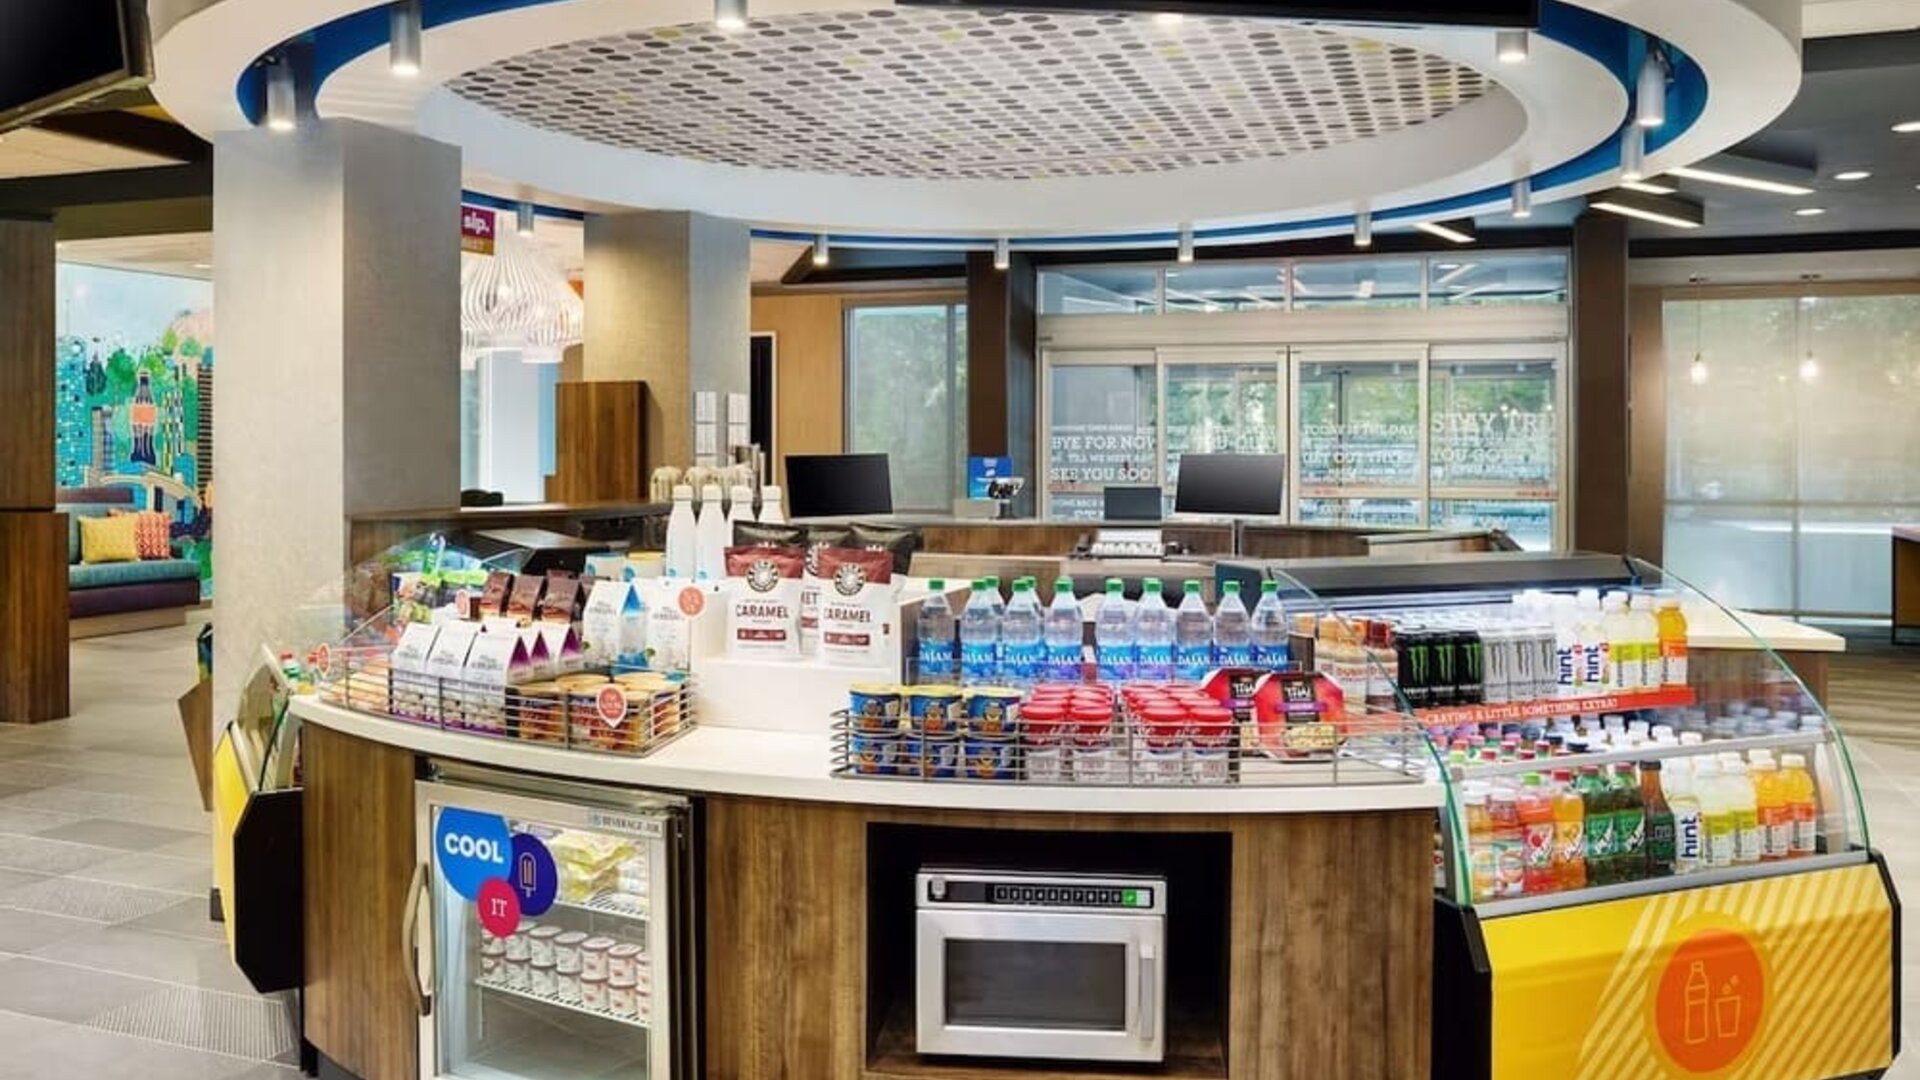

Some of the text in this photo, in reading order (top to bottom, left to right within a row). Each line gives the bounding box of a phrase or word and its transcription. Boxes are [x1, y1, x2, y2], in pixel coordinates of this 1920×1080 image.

[463, 211, 491, 235] sip.
[1052, 436, 1081, 450] BYE
[1084, 435, 1118, 450] FOR
[1081, 467, 1115, 481] YOU
[736, 603, 790, 619] CARAMEL
[824, 605, 871, 623] CARAMEL
[1556, 648, 1572, 685] hint
[1584, 645, 1599, 683] hint
[1425, 712, 1473, 725] CRAVING
[1486, 706, 1520, 718] LITTLE
[1522, 702, 1580, 715] SOMETHING
[444, 832, 504, 864] COOL
[1681, 815, 1698, 858] hint
[490, 898, 508, 917] IT
